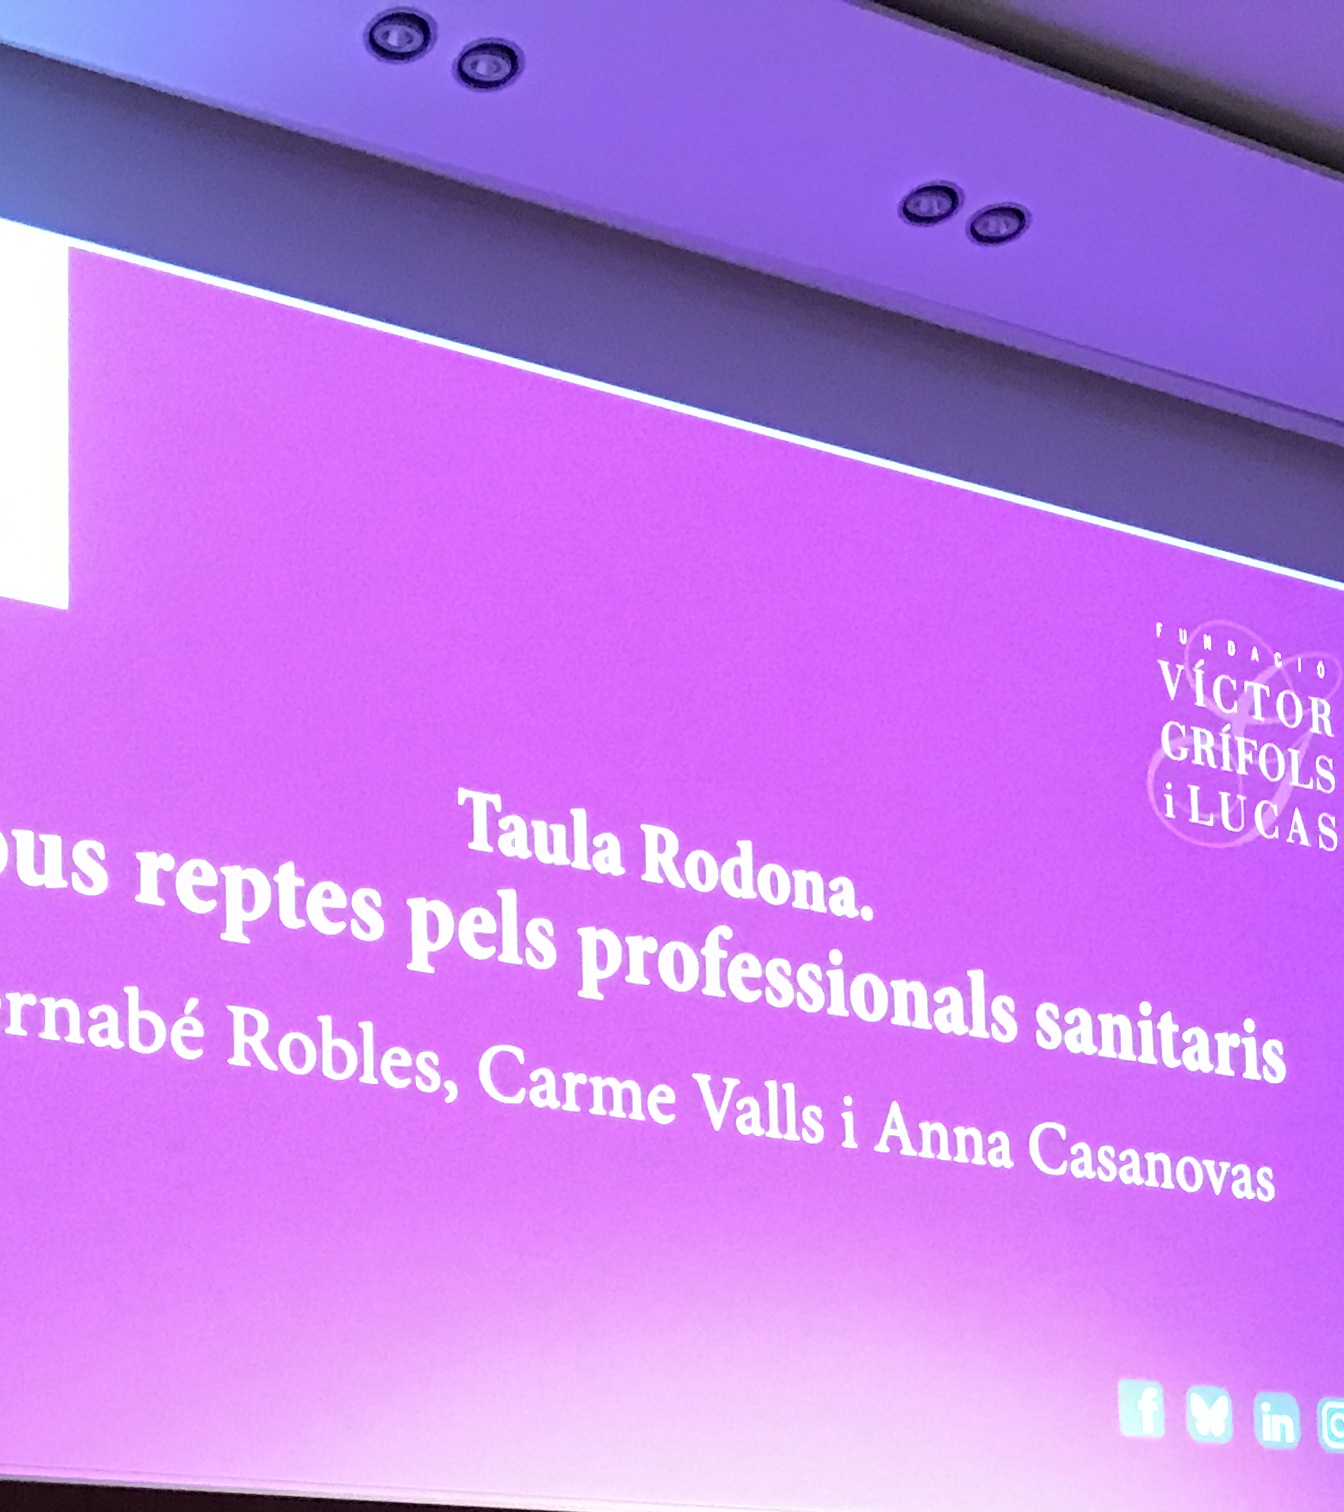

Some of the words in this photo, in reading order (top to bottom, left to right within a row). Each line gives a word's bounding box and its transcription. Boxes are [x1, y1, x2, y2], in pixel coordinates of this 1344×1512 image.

[1157, 659, 1334, 737] VÍCTOR
[1161, 721, 1335, 793] GRÍFOLS
[457, 787, 625, 877] Taula
[640, 824, 874, 921] Rodona.
[1164, 782, 1175, 818] i
[1187, 784, 1338, 851] LUCAS
[134, 848, 384, 944] reptes
[406, 888, 558, 973] pels
[578, 924, 1018, 1043] professionals
[1035, 1001, 1287, 1084] sanitaris
[227, 1005, 459, 1104] Robles,
[477, 1043, 676, 1125] Carme
[692, 1072, 825, 1145] Valls
[841, 1096, 858, 1149] i
[874, 1100, 1014, 1170] Anna
[1028, 1121, 1275, 1202] Casanovas
